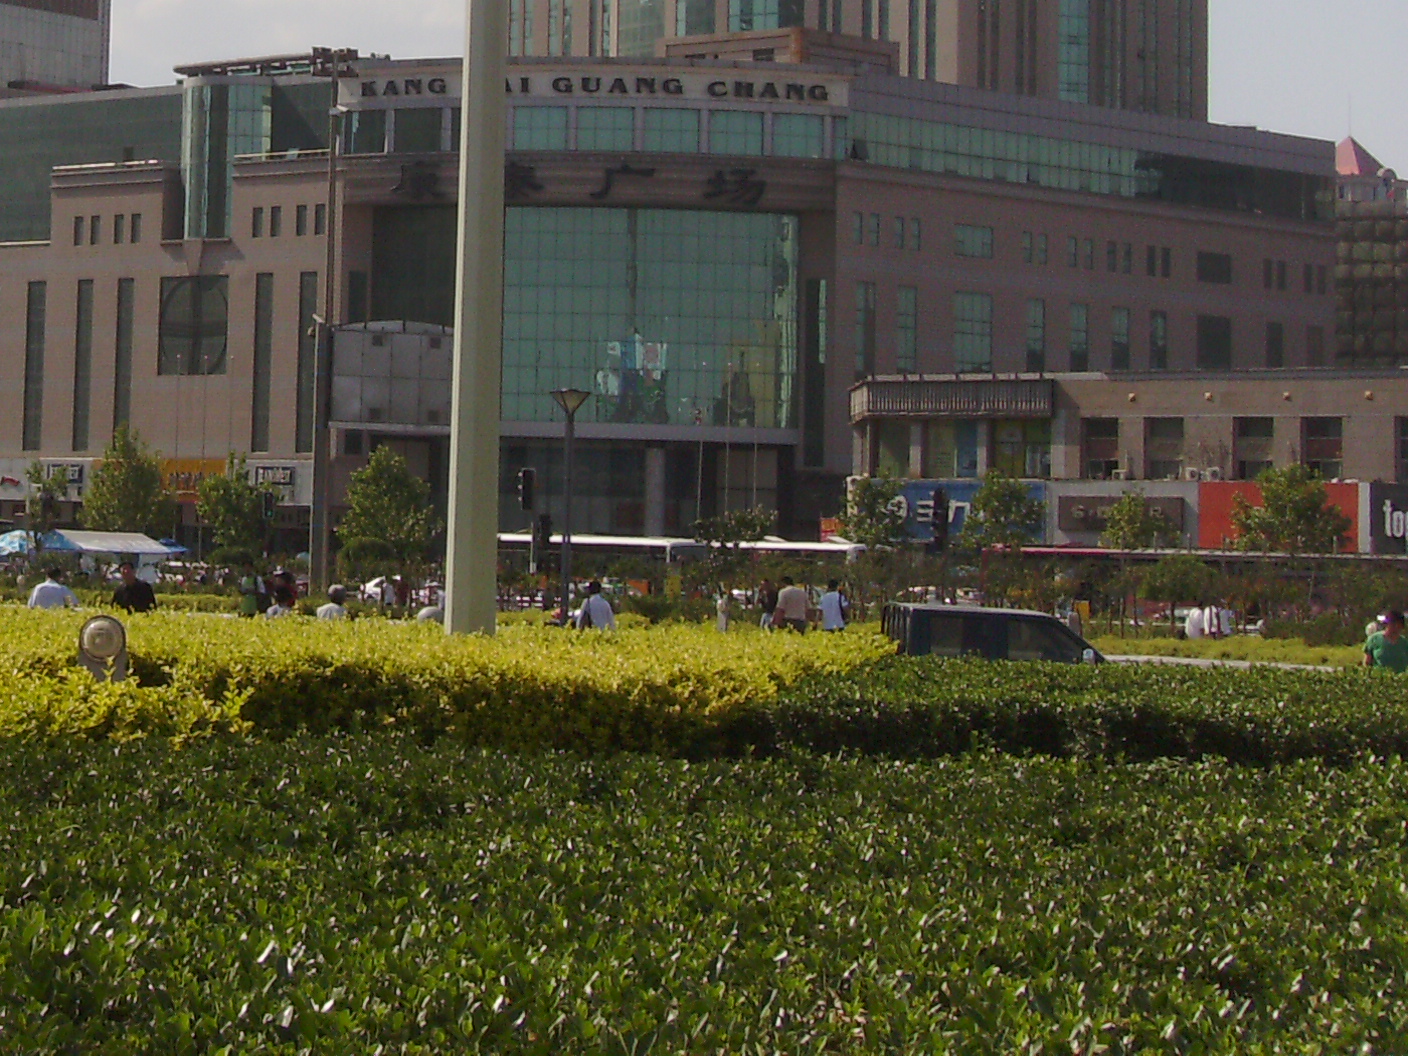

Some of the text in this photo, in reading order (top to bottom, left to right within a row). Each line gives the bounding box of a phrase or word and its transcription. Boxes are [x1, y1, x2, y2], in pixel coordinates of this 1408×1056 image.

[360, 76, 448, 97] KANG
[552, 76, 684, 96] GUANG
[707, 80, 830, 101] CHANG
[1382, 499, 1408, 538] to
